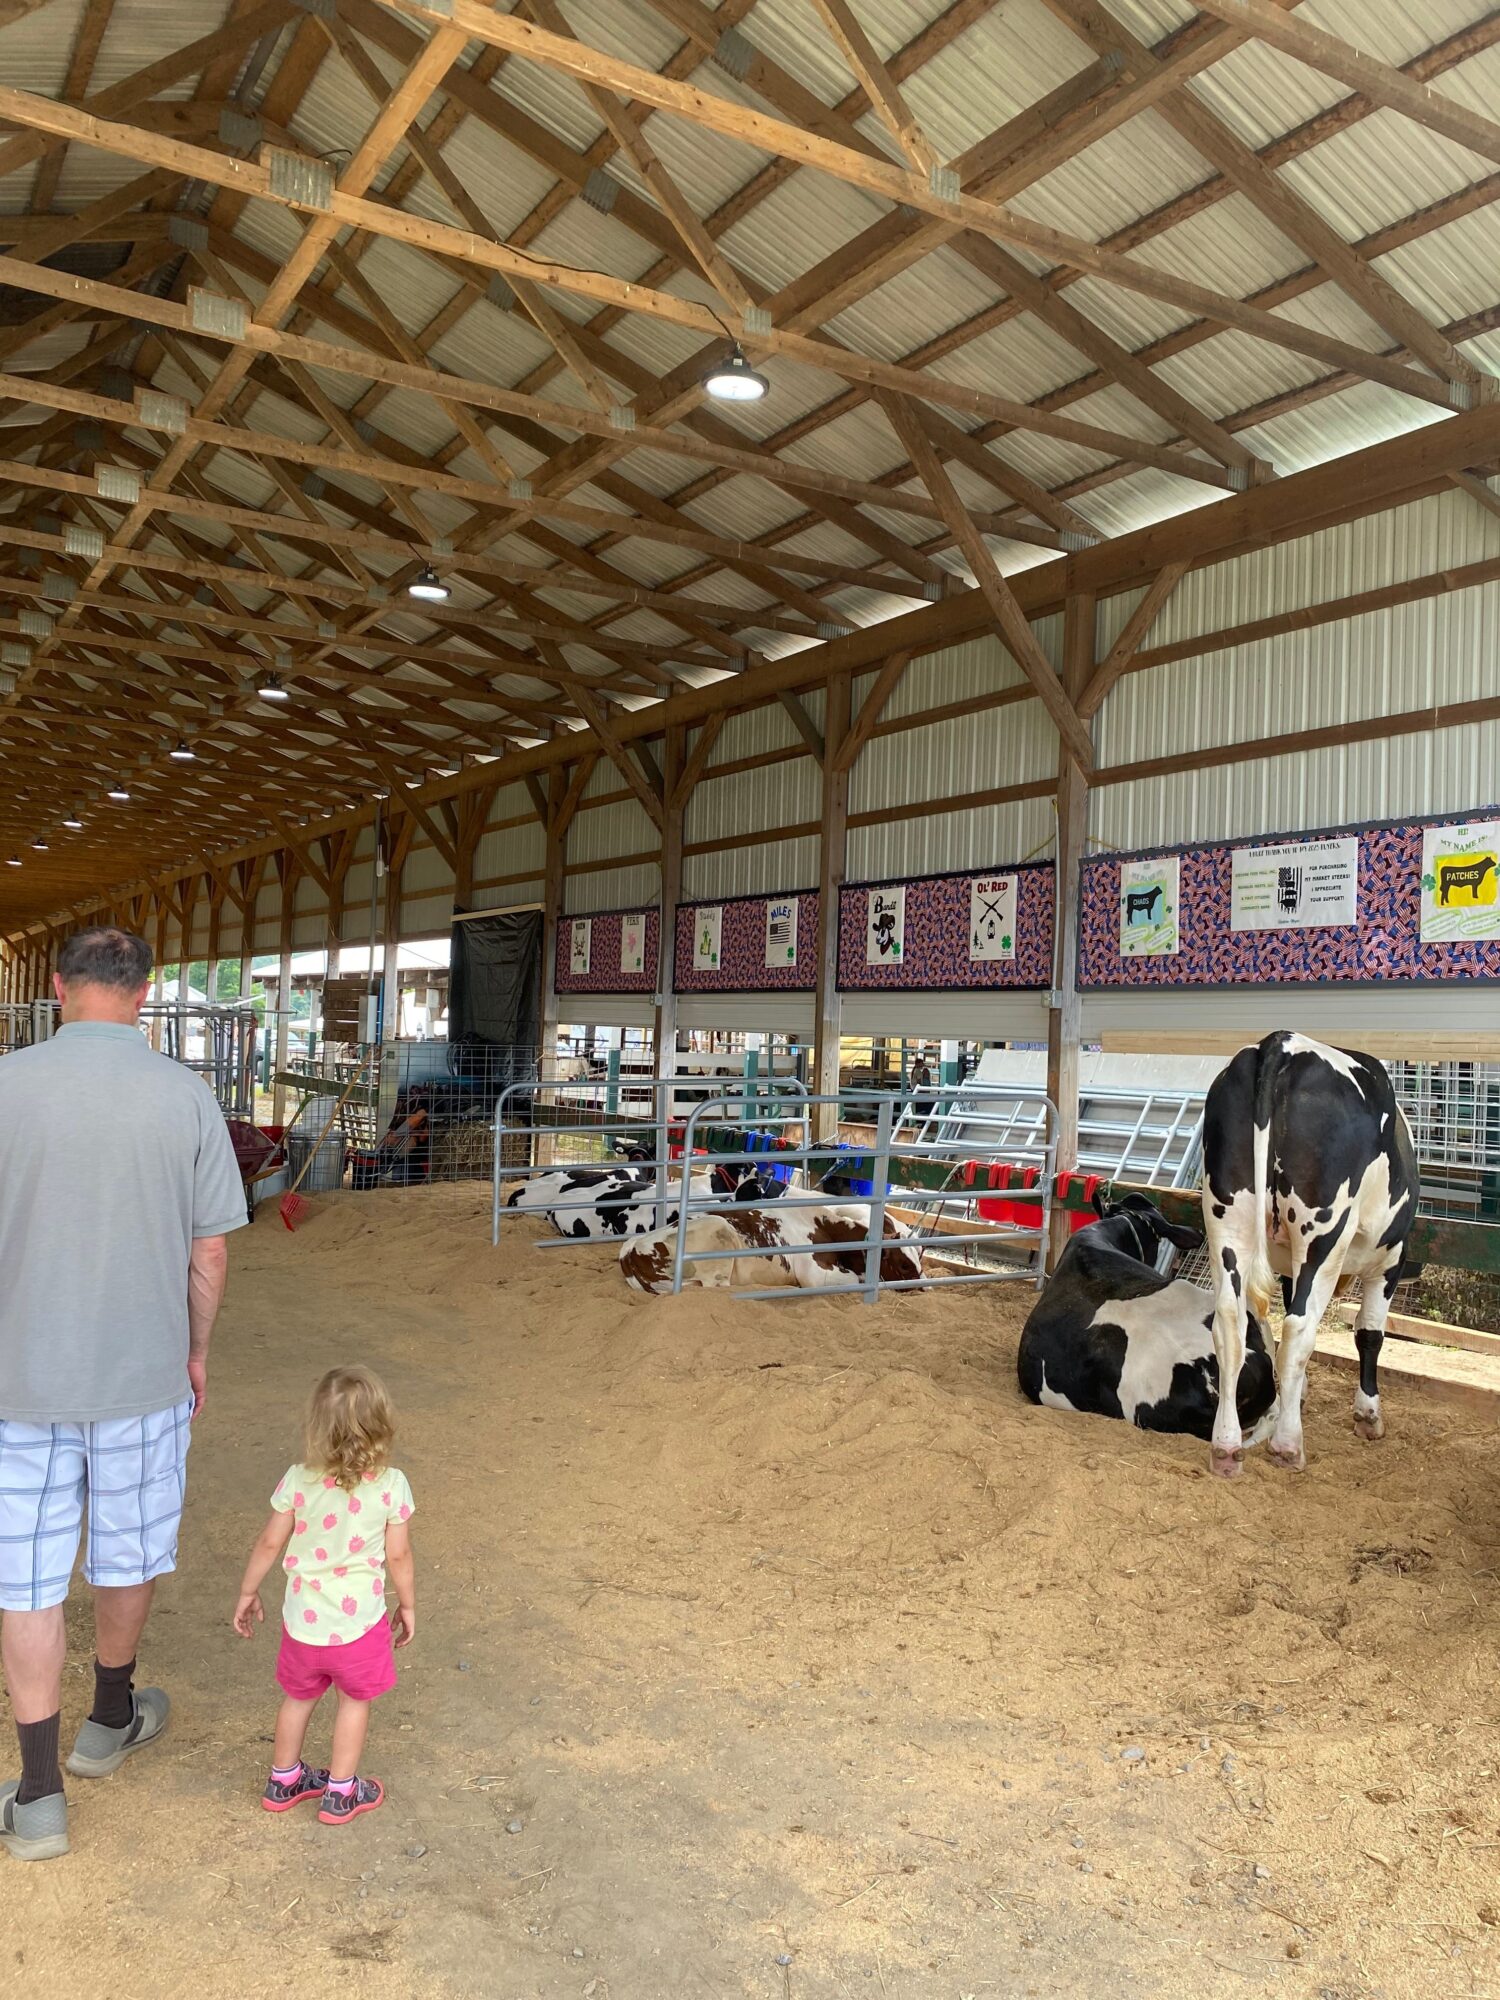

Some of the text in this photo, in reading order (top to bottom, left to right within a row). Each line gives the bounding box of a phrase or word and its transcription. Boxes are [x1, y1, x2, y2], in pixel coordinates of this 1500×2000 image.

[1440, 839, 1452, 847] MY
[1453, 839, 1477, 852] NAME
[1265, 848, 1281, 856] THANK
[1446, 871, 1479, 880] PATCHES
[977, 881, 1008, 893] OL' RED
[770, 906, 792, 921] MILES
